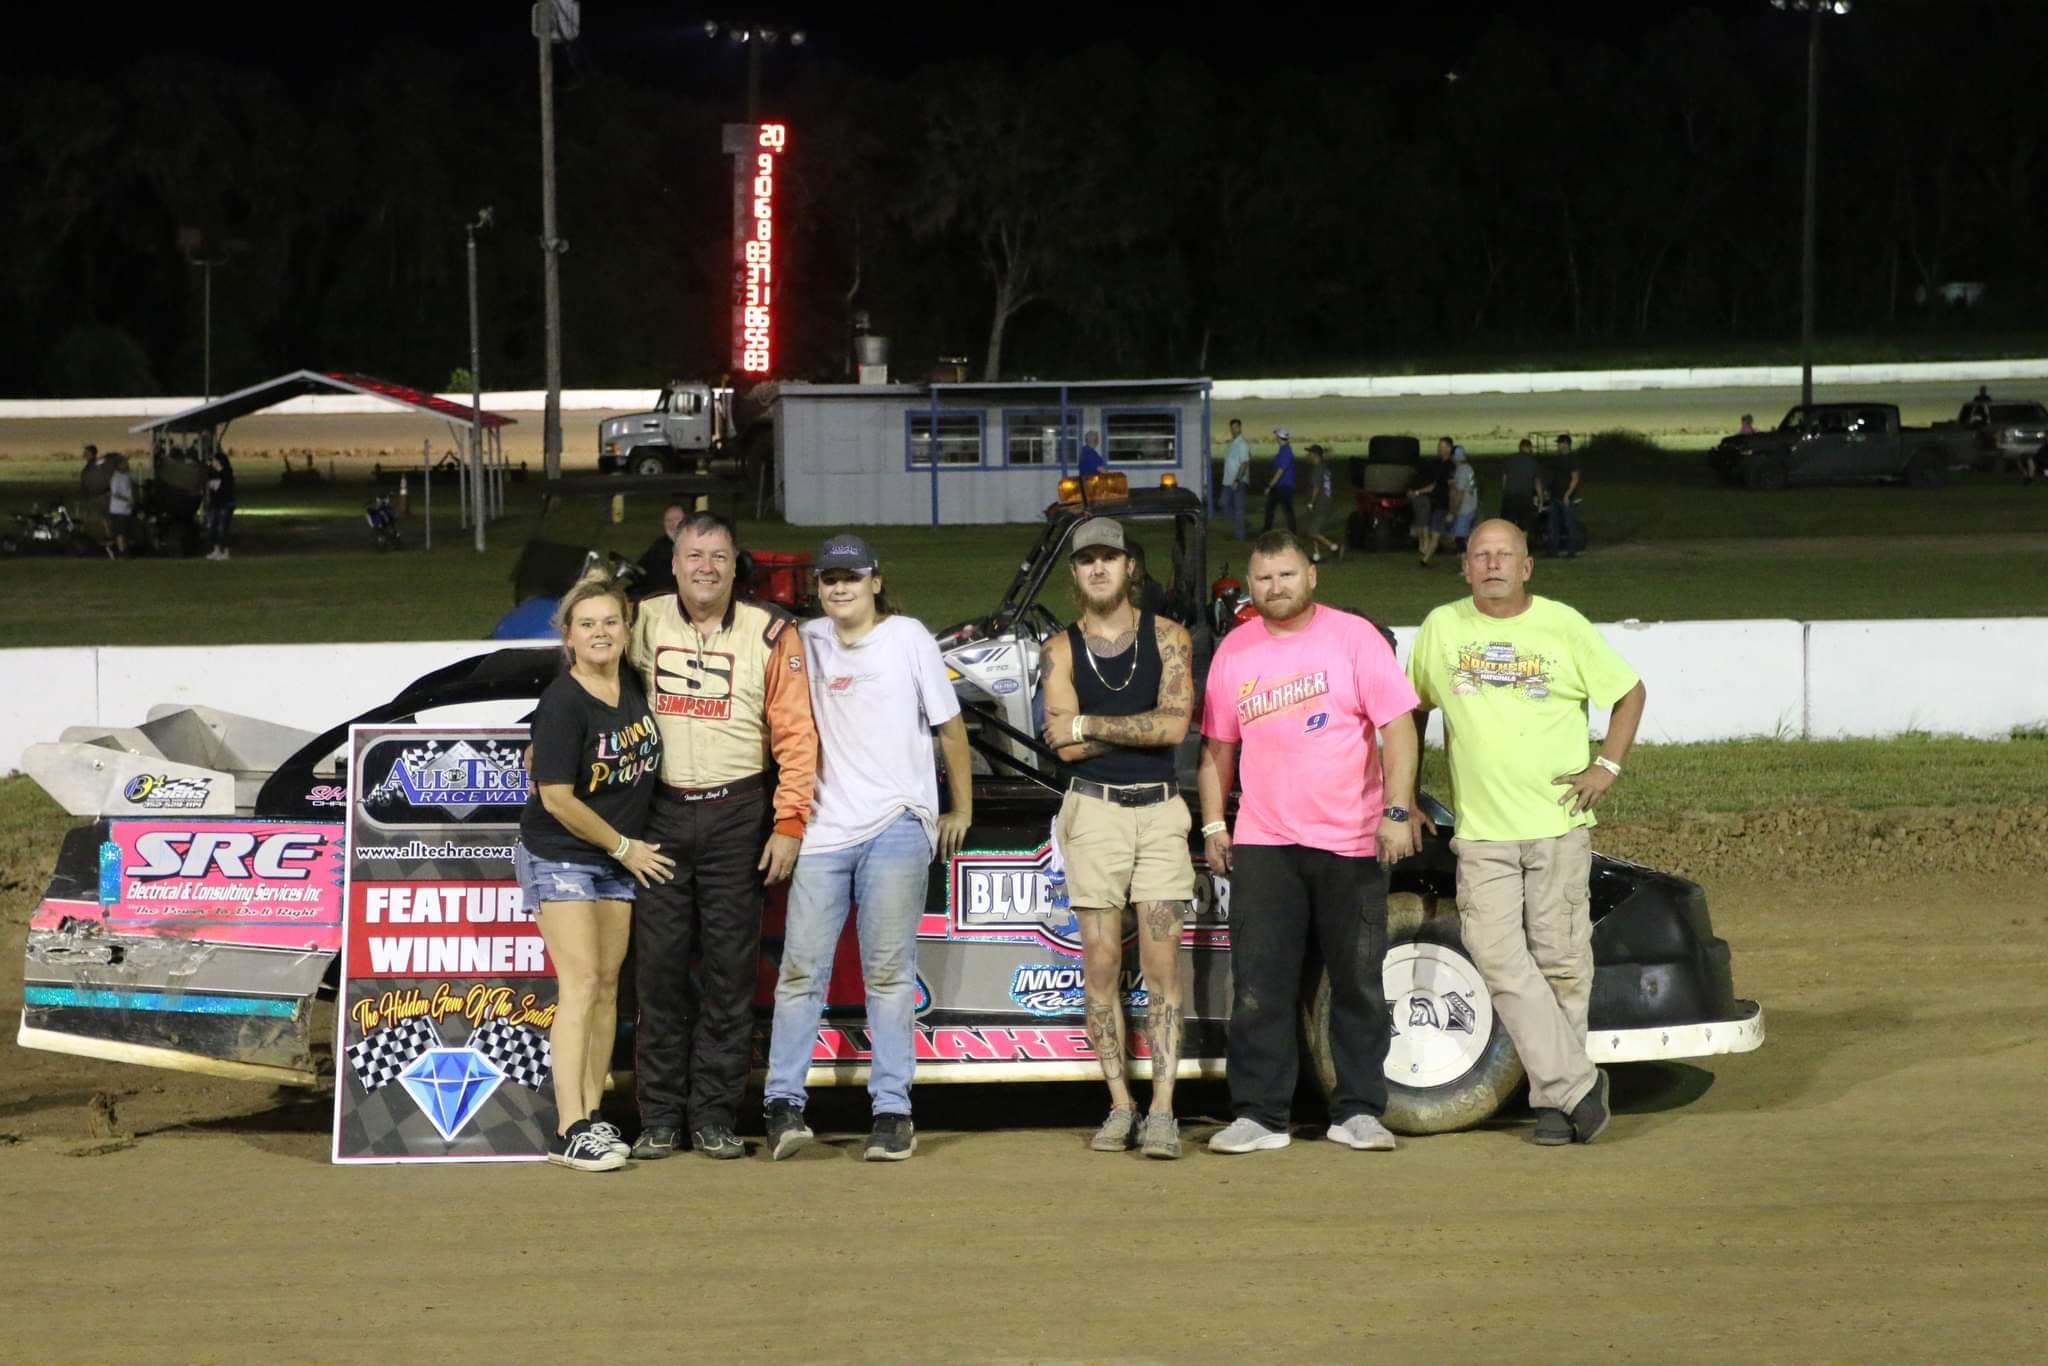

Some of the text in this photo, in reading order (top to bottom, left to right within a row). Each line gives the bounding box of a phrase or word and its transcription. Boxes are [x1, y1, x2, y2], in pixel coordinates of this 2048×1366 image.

[758, 153, 772, 175] 9
[757, 220, 772, 240] 8
[746, 241, 771, 261] 83
[746, 262, 771, 283] 37
[746, 284, 770, 305] 31
[743, 350, 769, 371] 83
[1459, 654, 1541, 677] SOUTHERN
[658, 695, 729, 717] SIMPSON
[1237, 671, 1329, 725] STALNAKER
[1303, 712, 1329, 735] 9
[619, 741, 652, 766] on a
[420, 791, 529, 802] RACEWAY
[125, 832, 326, 878] SRE
[127, 881, 322, 904] Electrical & Consulting Services Inc
[968, 871, 1054, 920] BLUE
[366, 887, 537, 923] FEATUR
[368, 936, 545, 973] WINNER
[352, 983, 560, 1036] The Hidden Gem Of The South
